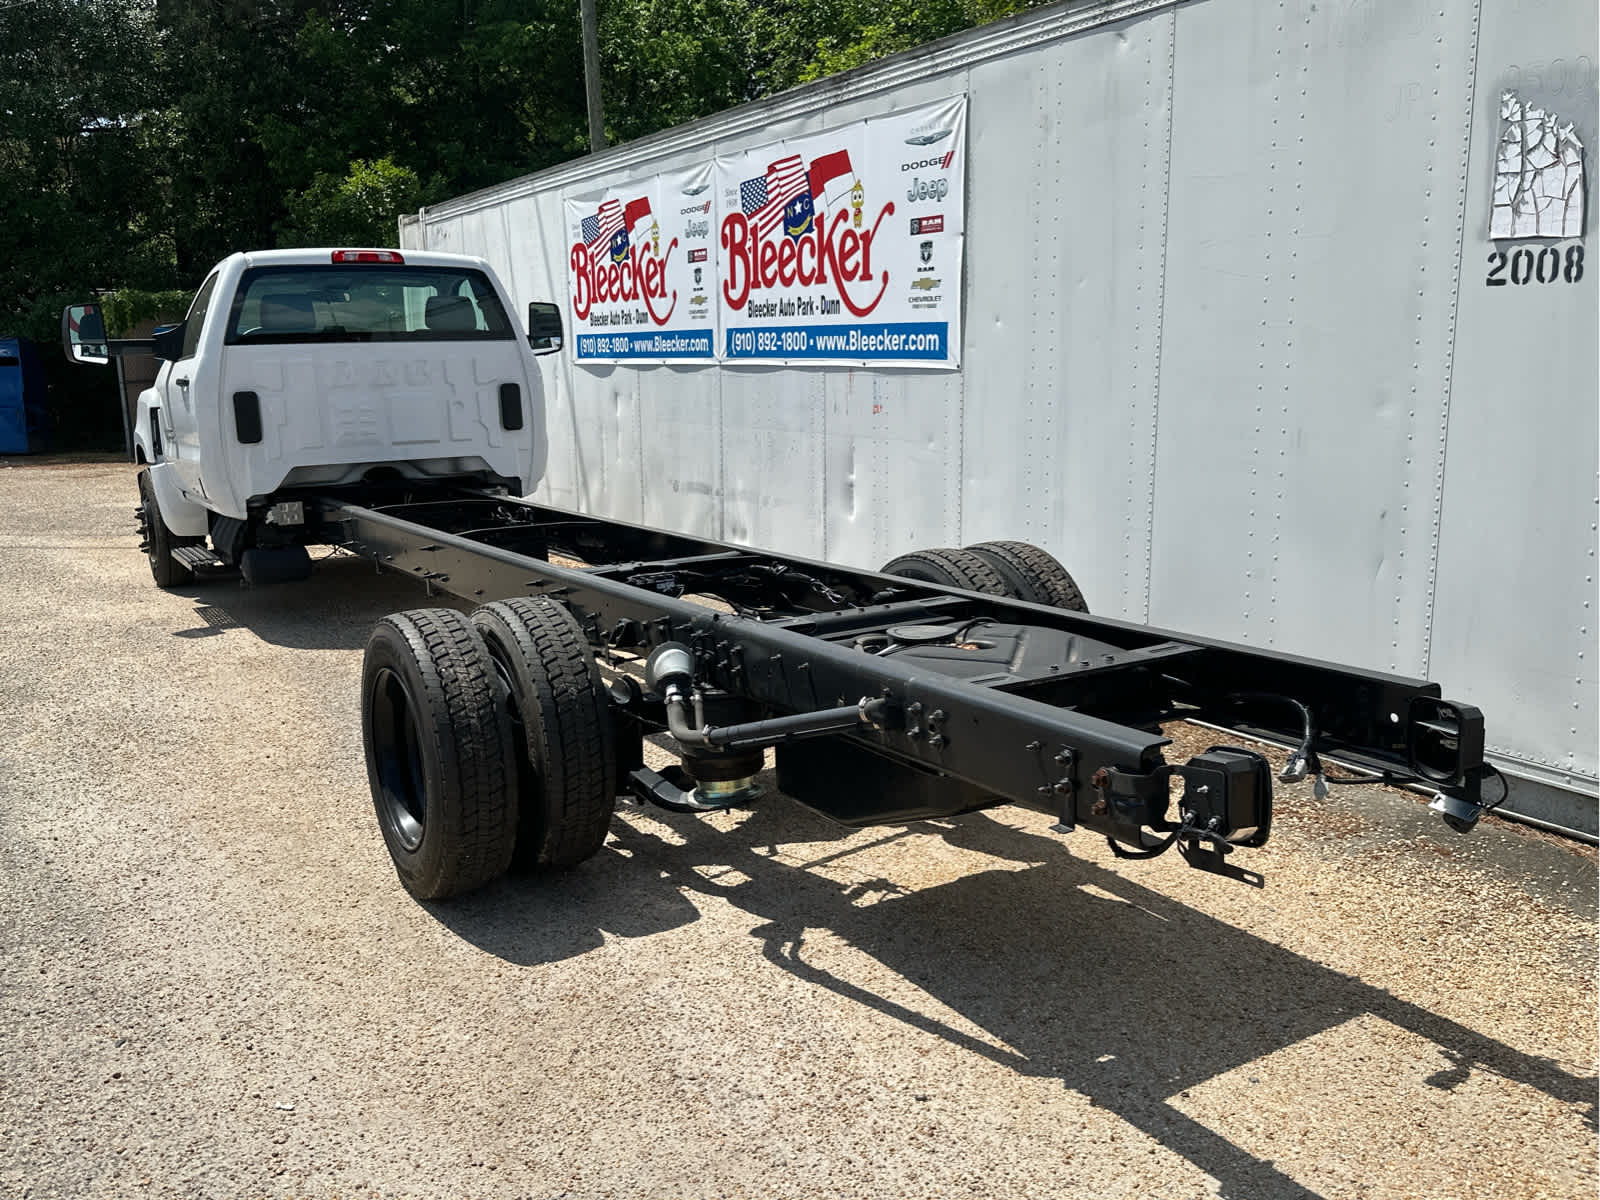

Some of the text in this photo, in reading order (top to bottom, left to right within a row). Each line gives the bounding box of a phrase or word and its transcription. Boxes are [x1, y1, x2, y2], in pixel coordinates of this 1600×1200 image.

[901, 156, 945, 171] DODGE
[907, 177, 949, 202] Jeep
[680, 204, 705, 215] DODGE
[685, 219, 709, 239] Jeep
[922, 217, 942, 226] RAM
[721, 201, 895, 318] Bleecker
[1486, 245, 1585, 287] 2008
[571, 237, 678, 326] Bleecker
[590, 311, 609, 327] Bleecker
[610, 309, 620, 325] Auto
[621, 308, 632, 325] Park
[635, 308, 648, 324] Dunn
[748, 299, 777, 319] Bleecker
[778, 297, 795, 317] Auto
[797, 296, 814, 316] Park
[820, 295, 840, 315] Dunn
[580, 335, 709, 356] (910) 892-1800 www.Bleecker.com
[731, 329, 940, 355] (910) 892-1800 www.Bleecker.com
